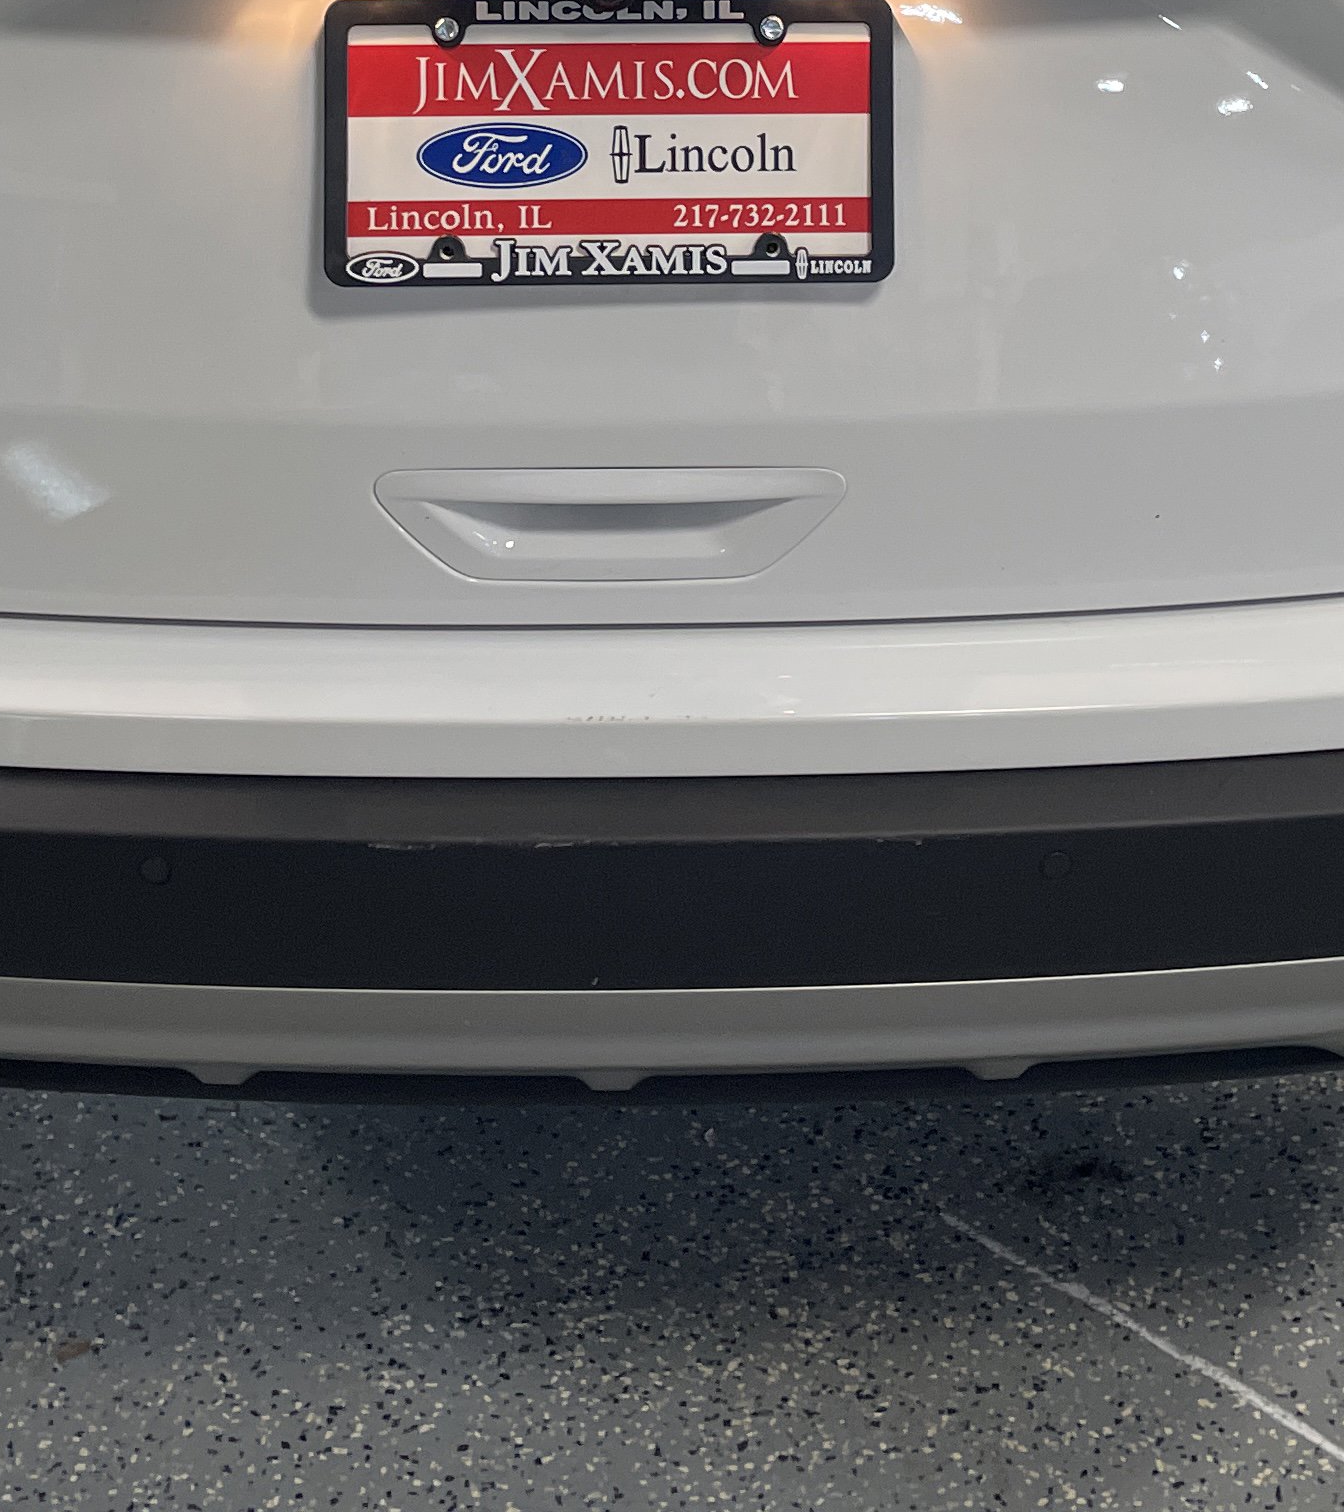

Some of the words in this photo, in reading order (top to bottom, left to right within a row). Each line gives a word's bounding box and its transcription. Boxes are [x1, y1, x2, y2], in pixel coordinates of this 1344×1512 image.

[703, 0, 744, 20] IL
[413, 49, 798, 114] JIMXAMIS.COM
[634, 134, 796, 174] Lincoln
[367, 204, 505, 232] Lincoln,
[518, 205, 552, 229] IL
[673, 203, 847, 228] 217-732-2111
[491, 240, 571, 283] JIM
[580, 240, 727, 278] XAMIS
[810, 259, 872, 275] LINCOLN
